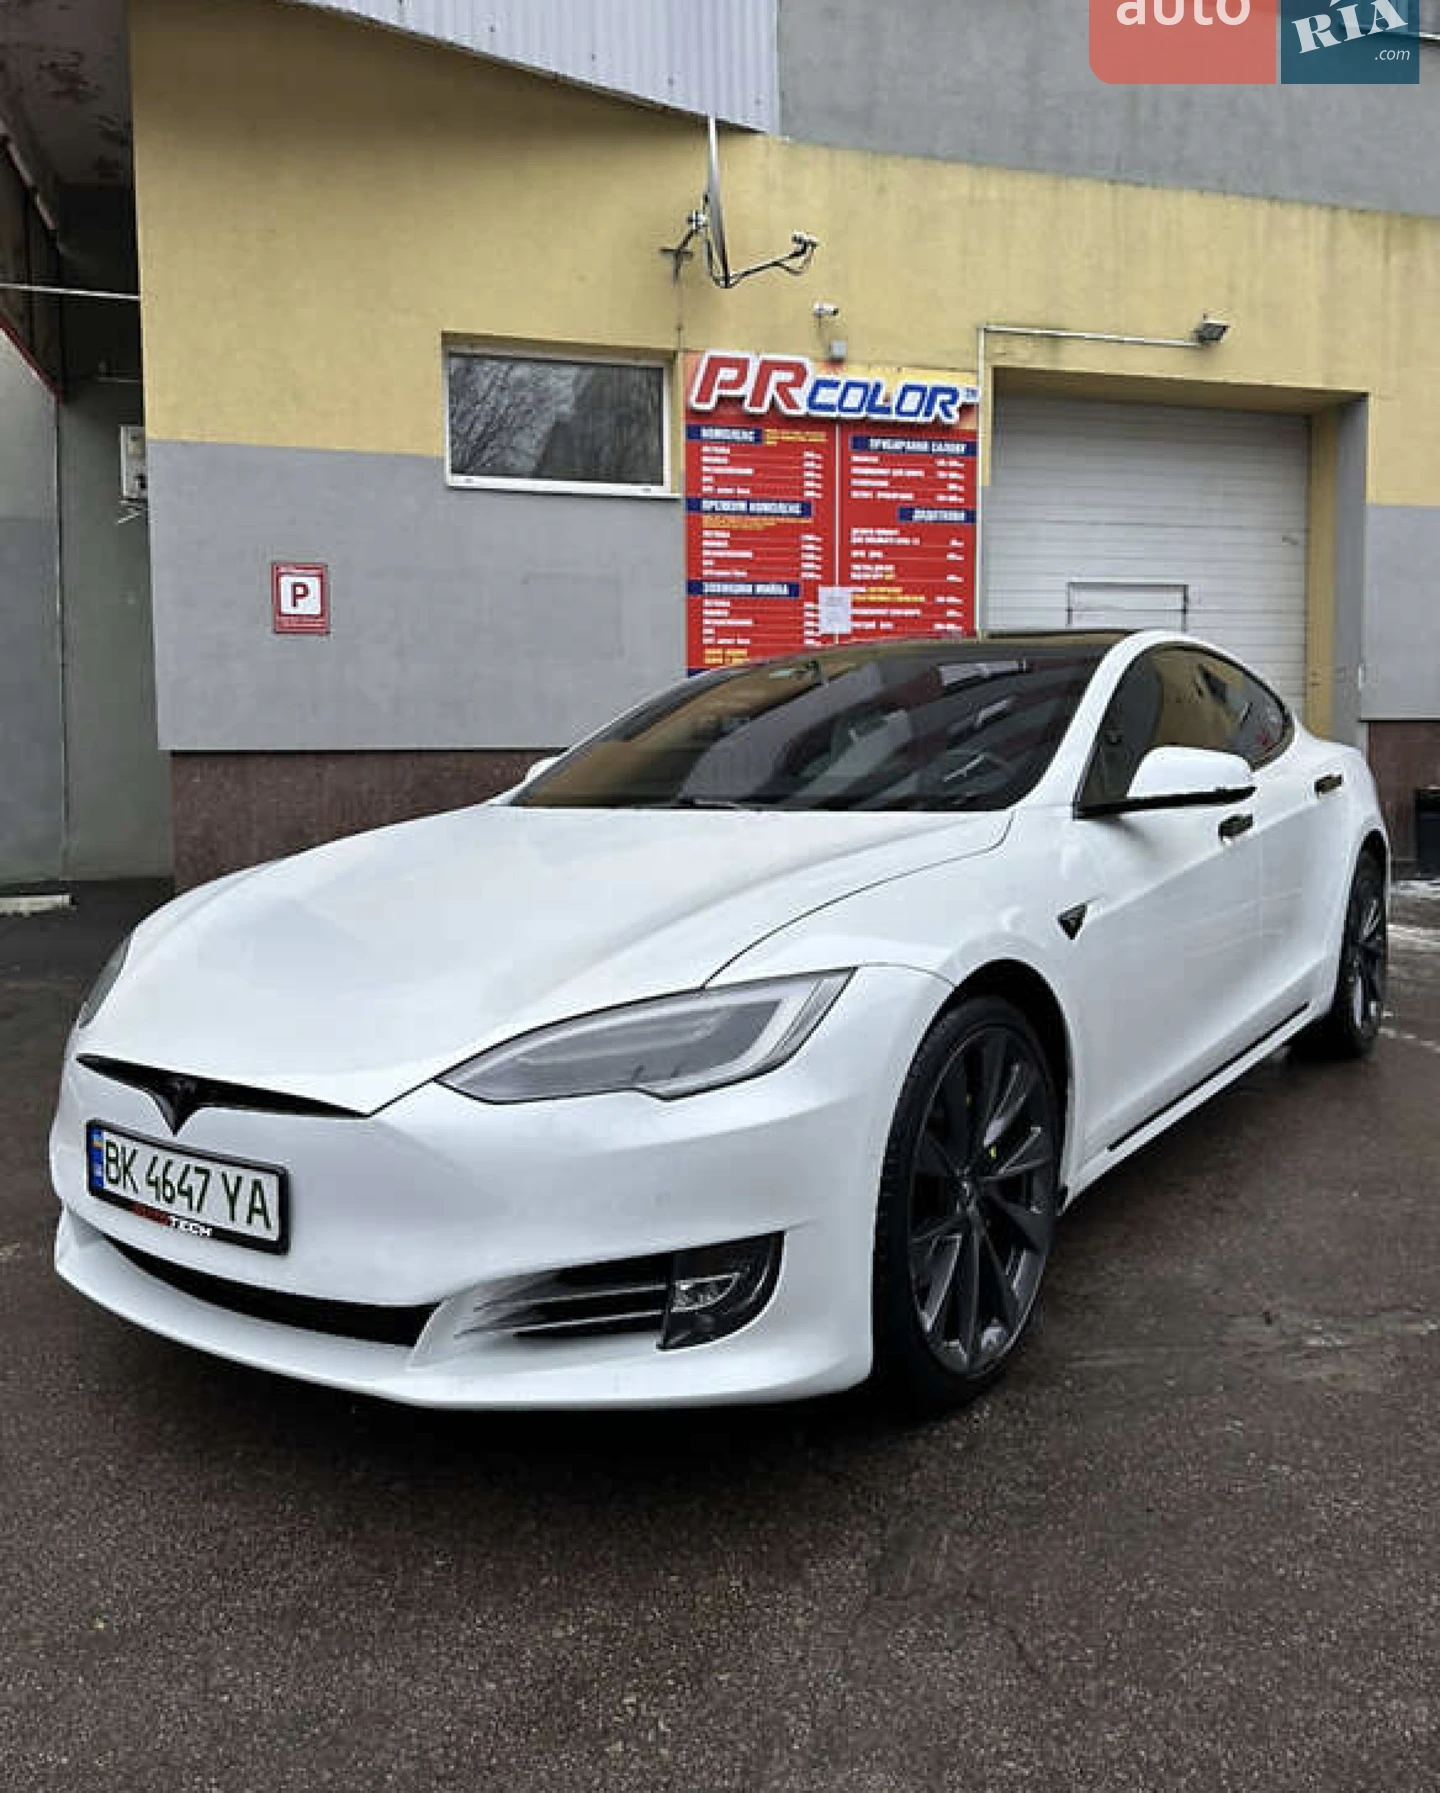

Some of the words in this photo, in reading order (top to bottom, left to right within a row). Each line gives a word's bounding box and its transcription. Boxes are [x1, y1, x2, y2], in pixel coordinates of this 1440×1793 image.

[693, 353, 809, 412] PR
[805, 378, 961, 419] COLOR
[290, 581, 311, 608] P
[104, 1140, 140, 1195] BK
[145, 1154, 212, 1214] 4647
[221, 1171, 272, 1230] YA
